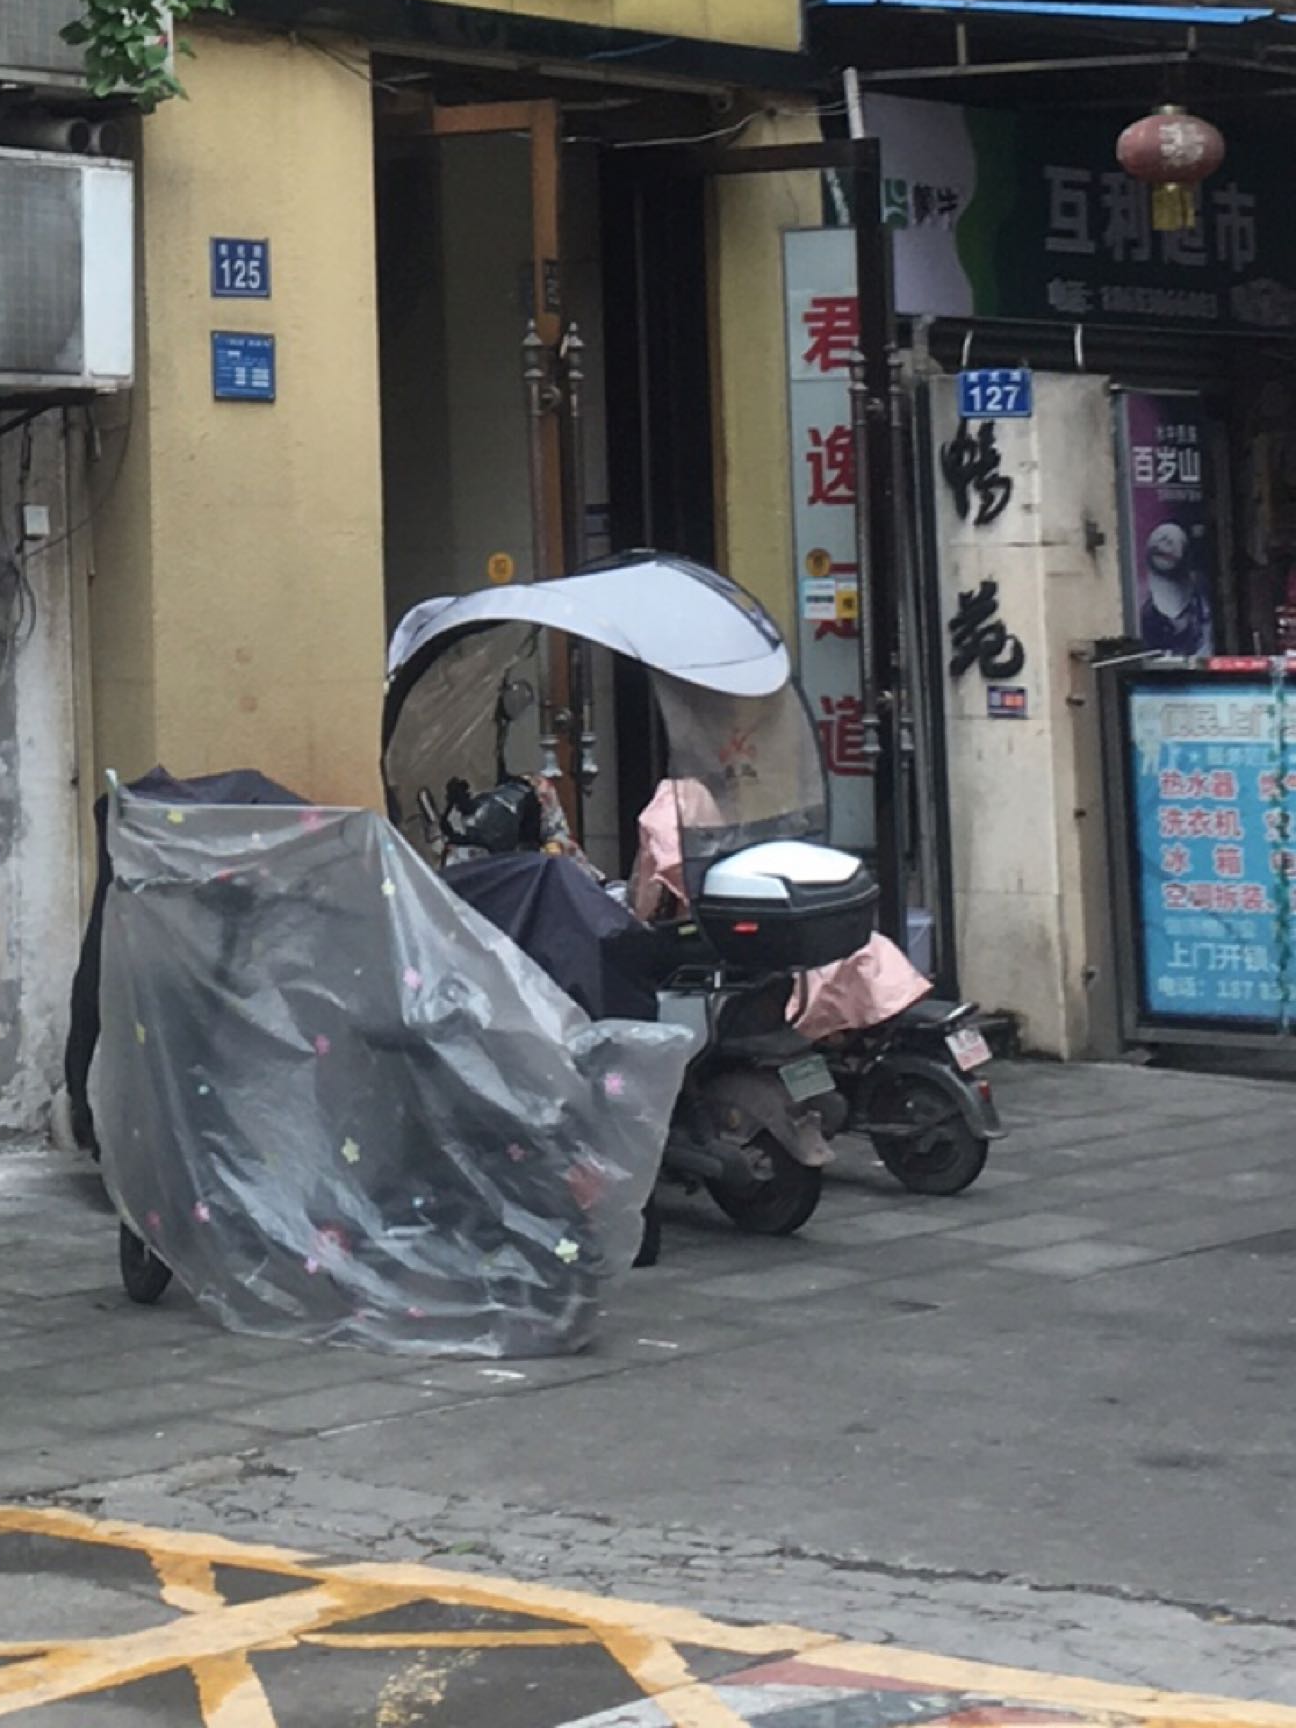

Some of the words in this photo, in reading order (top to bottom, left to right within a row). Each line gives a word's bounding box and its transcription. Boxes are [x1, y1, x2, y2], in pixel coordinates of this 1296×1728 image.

[220, 259, 261, 289] 125
[969, 385, 1020, 412] 127
[1132, 445, 1201, 484] 百岁山
[1160, 771, 1236, 799] 热水器
[1160, 807, 1243, 838] 洗衣机
